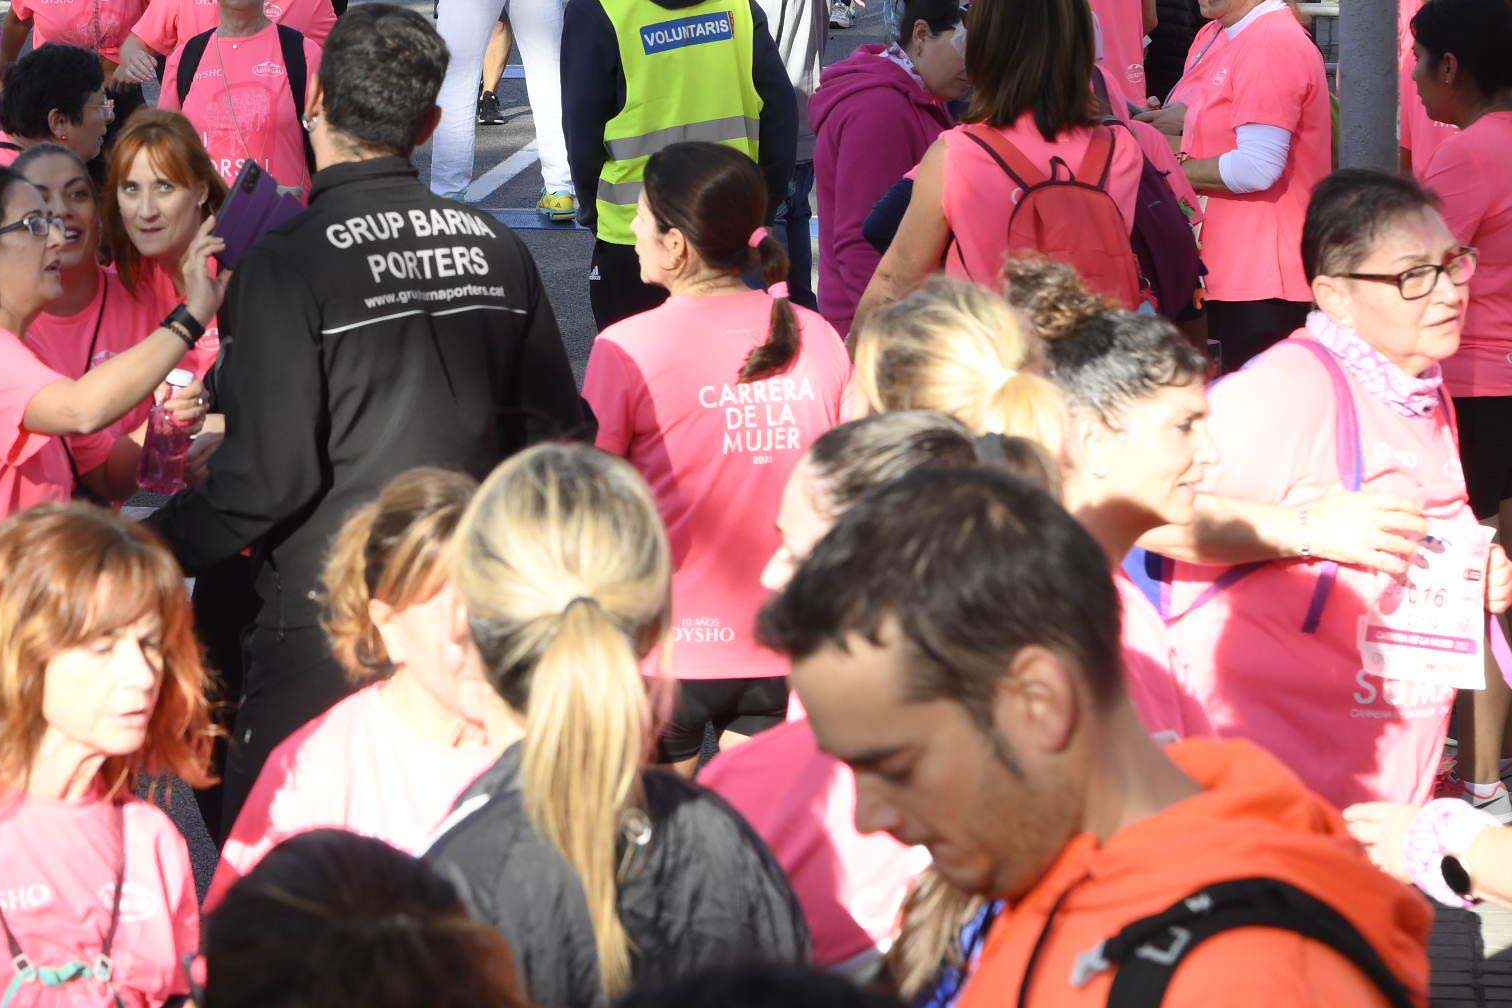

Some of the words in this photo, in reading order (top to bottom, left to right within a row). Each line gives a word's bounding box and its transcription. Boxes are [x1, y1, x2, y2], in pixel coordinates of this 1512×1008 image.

[643, 18, 730, 48] VOLUNTARIS
[326, 211, 405, 249] GRUP
[407, 208, 496, 239] BARNA
[366, 245, 489, 283] PORTERS
[698, 377, 816, 409] CARRERA
[724, 405, 758, 431] DE
[764, 402, 797, 428] LA
[722, 426, 801, 456] MUJER
